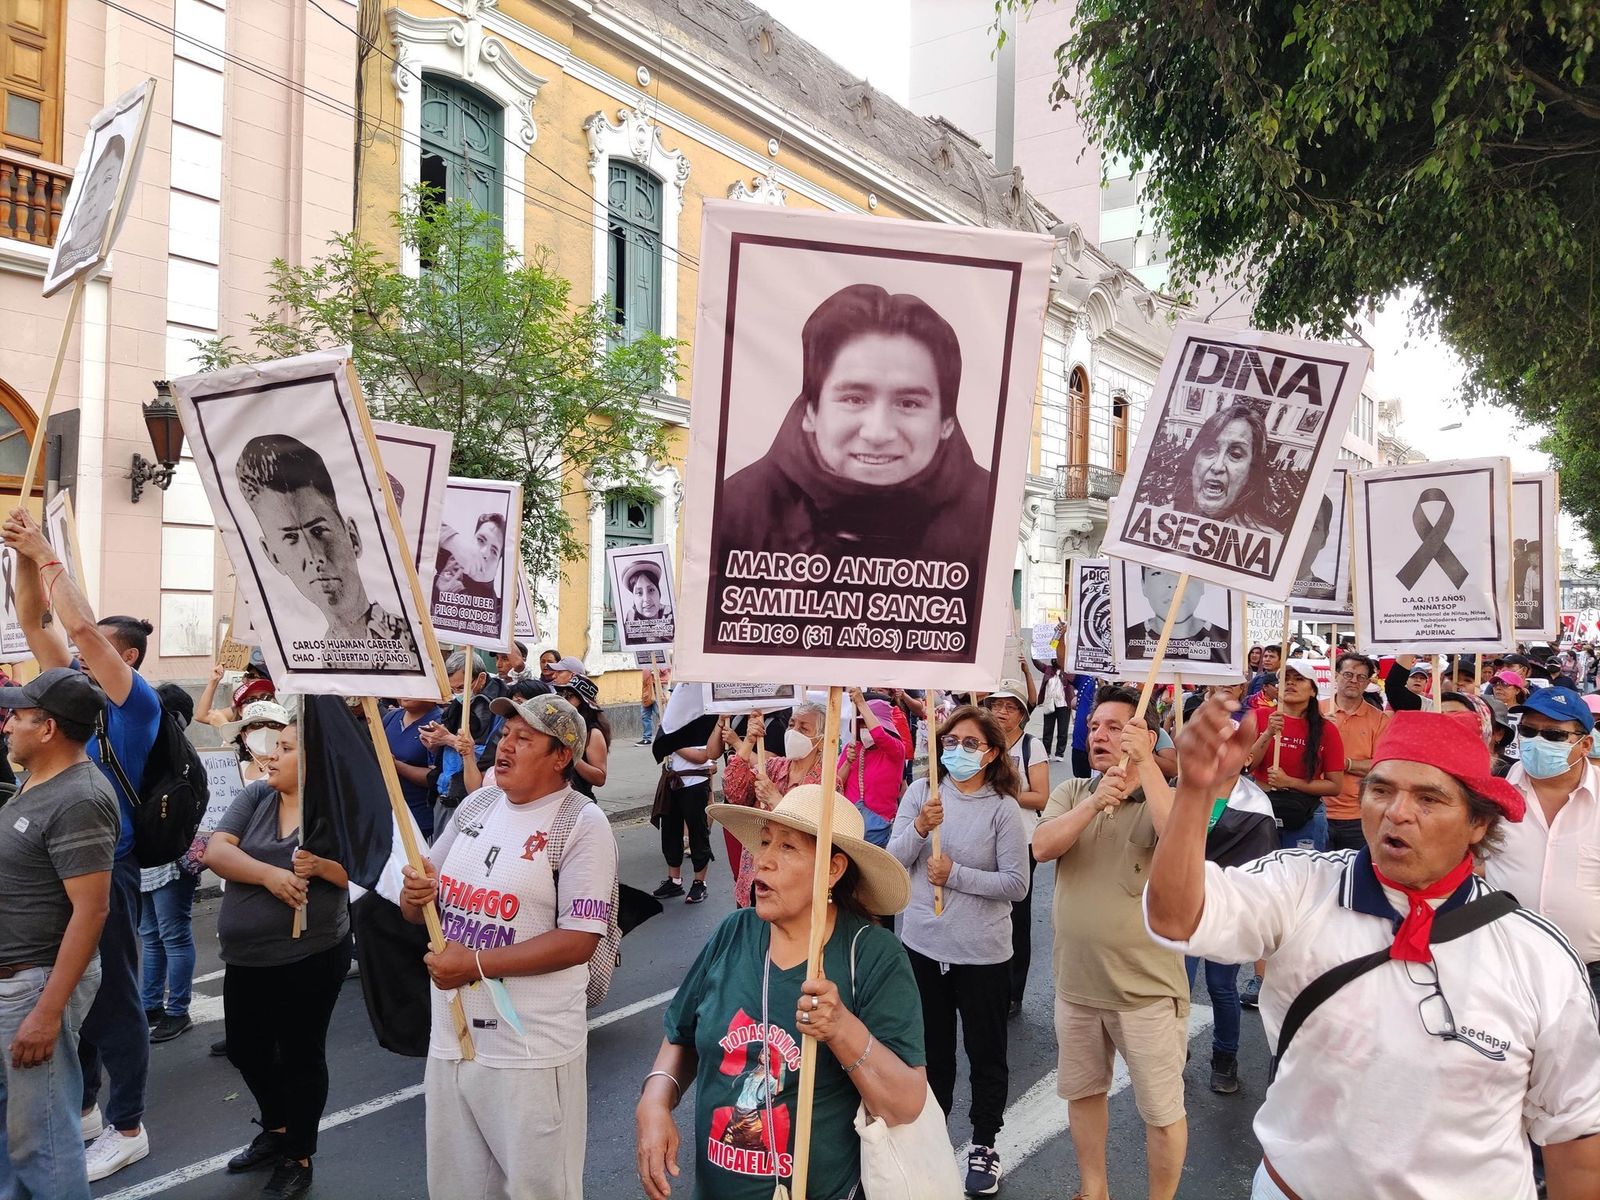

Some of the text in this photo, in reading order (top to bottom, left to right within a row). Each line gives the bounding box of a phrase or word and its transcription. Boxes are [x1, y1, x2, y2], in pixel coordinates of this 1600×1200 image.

[1185, 344, 1322, 406] DINA
[1128, 508, 1273, 574] ASESINA
[726, 550, 969, 590] MARCO ANTONIO
[435, 604, 496, 623] PILCO CONDORI
[439, 592, 494, 608] NELSON UBER
[721, 586, 966, 624] SAMILLAN SANGA
[1442, 594, 1466, 602] AÑOS)
[292, 640, 404, 650] CARLOS HUAMAN CABRERA
[718, 618, 965, 653] MÉDICO (31 AÑOS) PUNO
[1196, 641, 1228, 649] GALINDO
[292, 654, 314, 662] CHAO
[322, 654, 332, 662] LA
[334, 654, 369, 662] LIBERTAD
[372, 654, 383, 664] (26
[386, 650, 411, 664] AÑOS)
[440, 874, 520, 922] THIAGO
[719, 1024, 801, 1072] TODAS SOMOS
[1460, 1025, 1511, 1052] sedapal
[708, 1137, 792, 1178] MICAELAS
